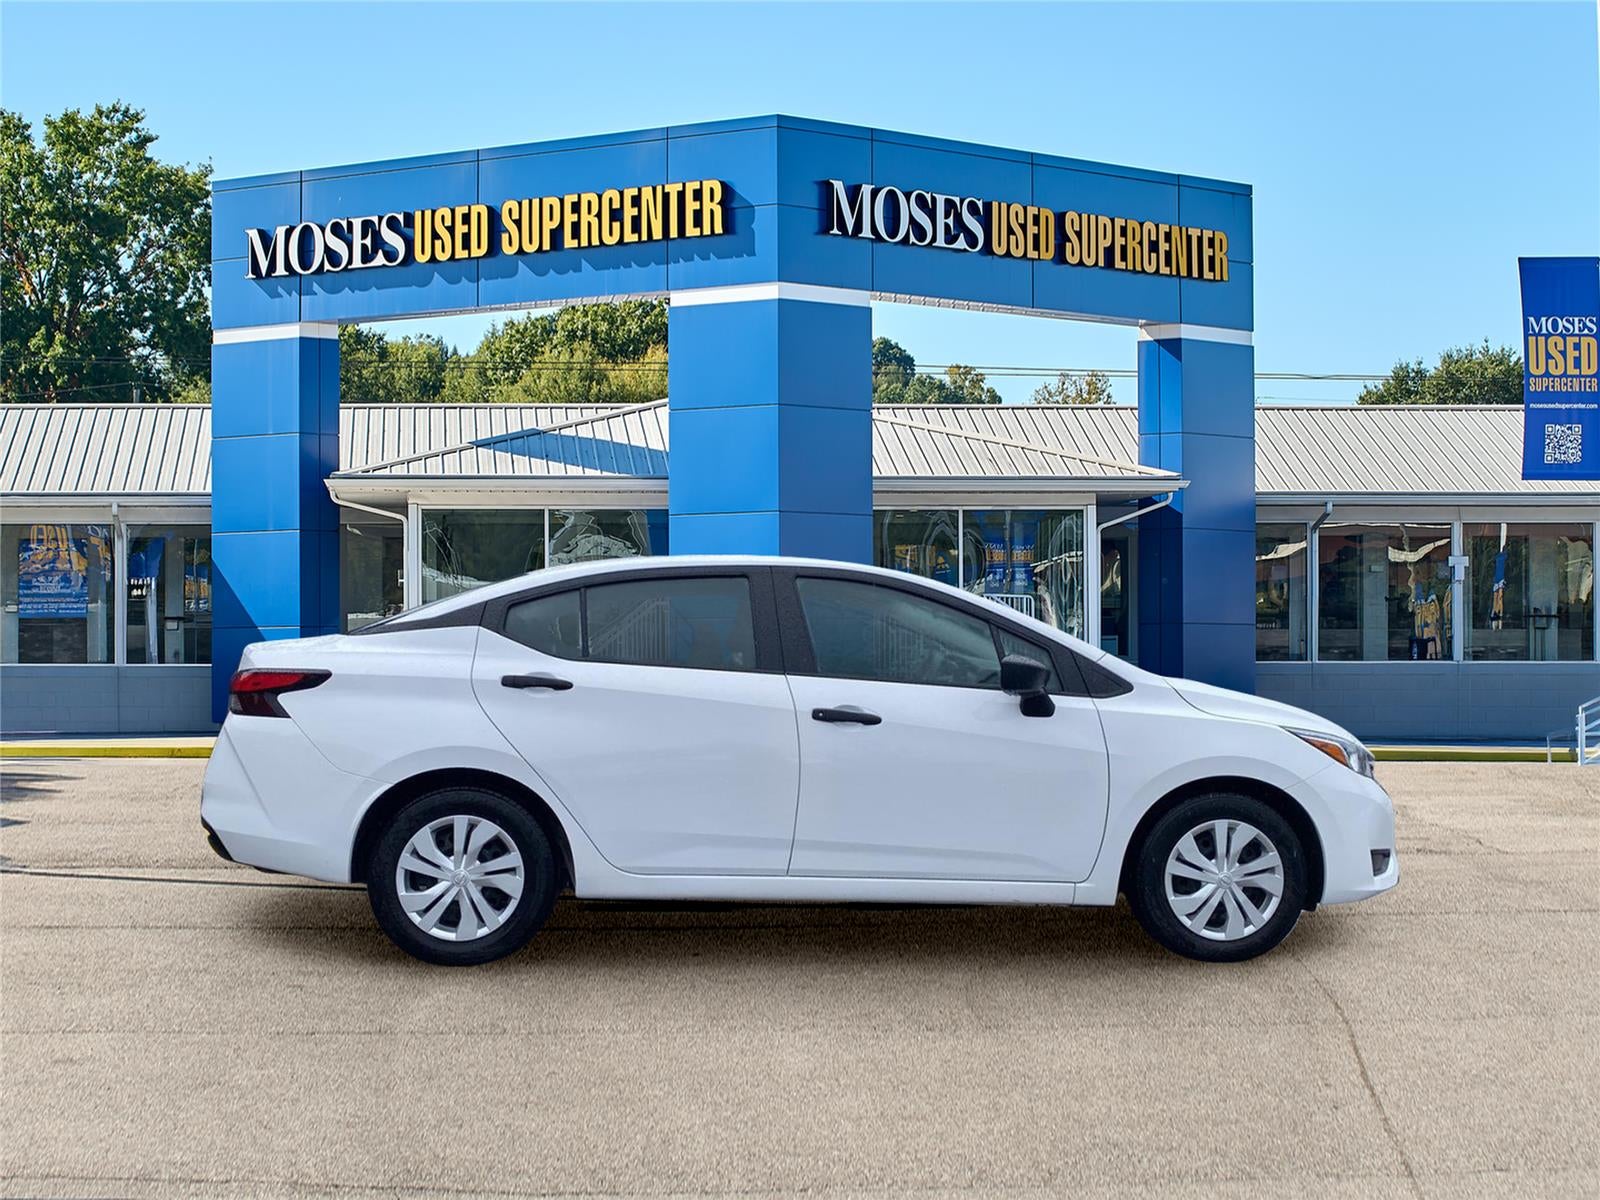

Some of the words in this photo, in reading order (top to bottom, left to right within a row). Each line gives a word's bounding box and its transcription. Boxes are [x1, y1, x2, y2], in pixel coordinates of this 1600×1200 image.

[245, 212, 408, 279] MOSES
[412, 204, 489, 263] USED
[501, 179, 724, 255] SUPERCENTER
[828, 179, 985, 252] MOSES
[990, 201, 1056, 260] USED
[1064, 211, 1230, 281] SUPERCENTER
[1527, 316, 1597, 334] MOSES
[1528, 336, 1598, 375] USED
[1529, 377, 1598, 392] SUPERCENTER
